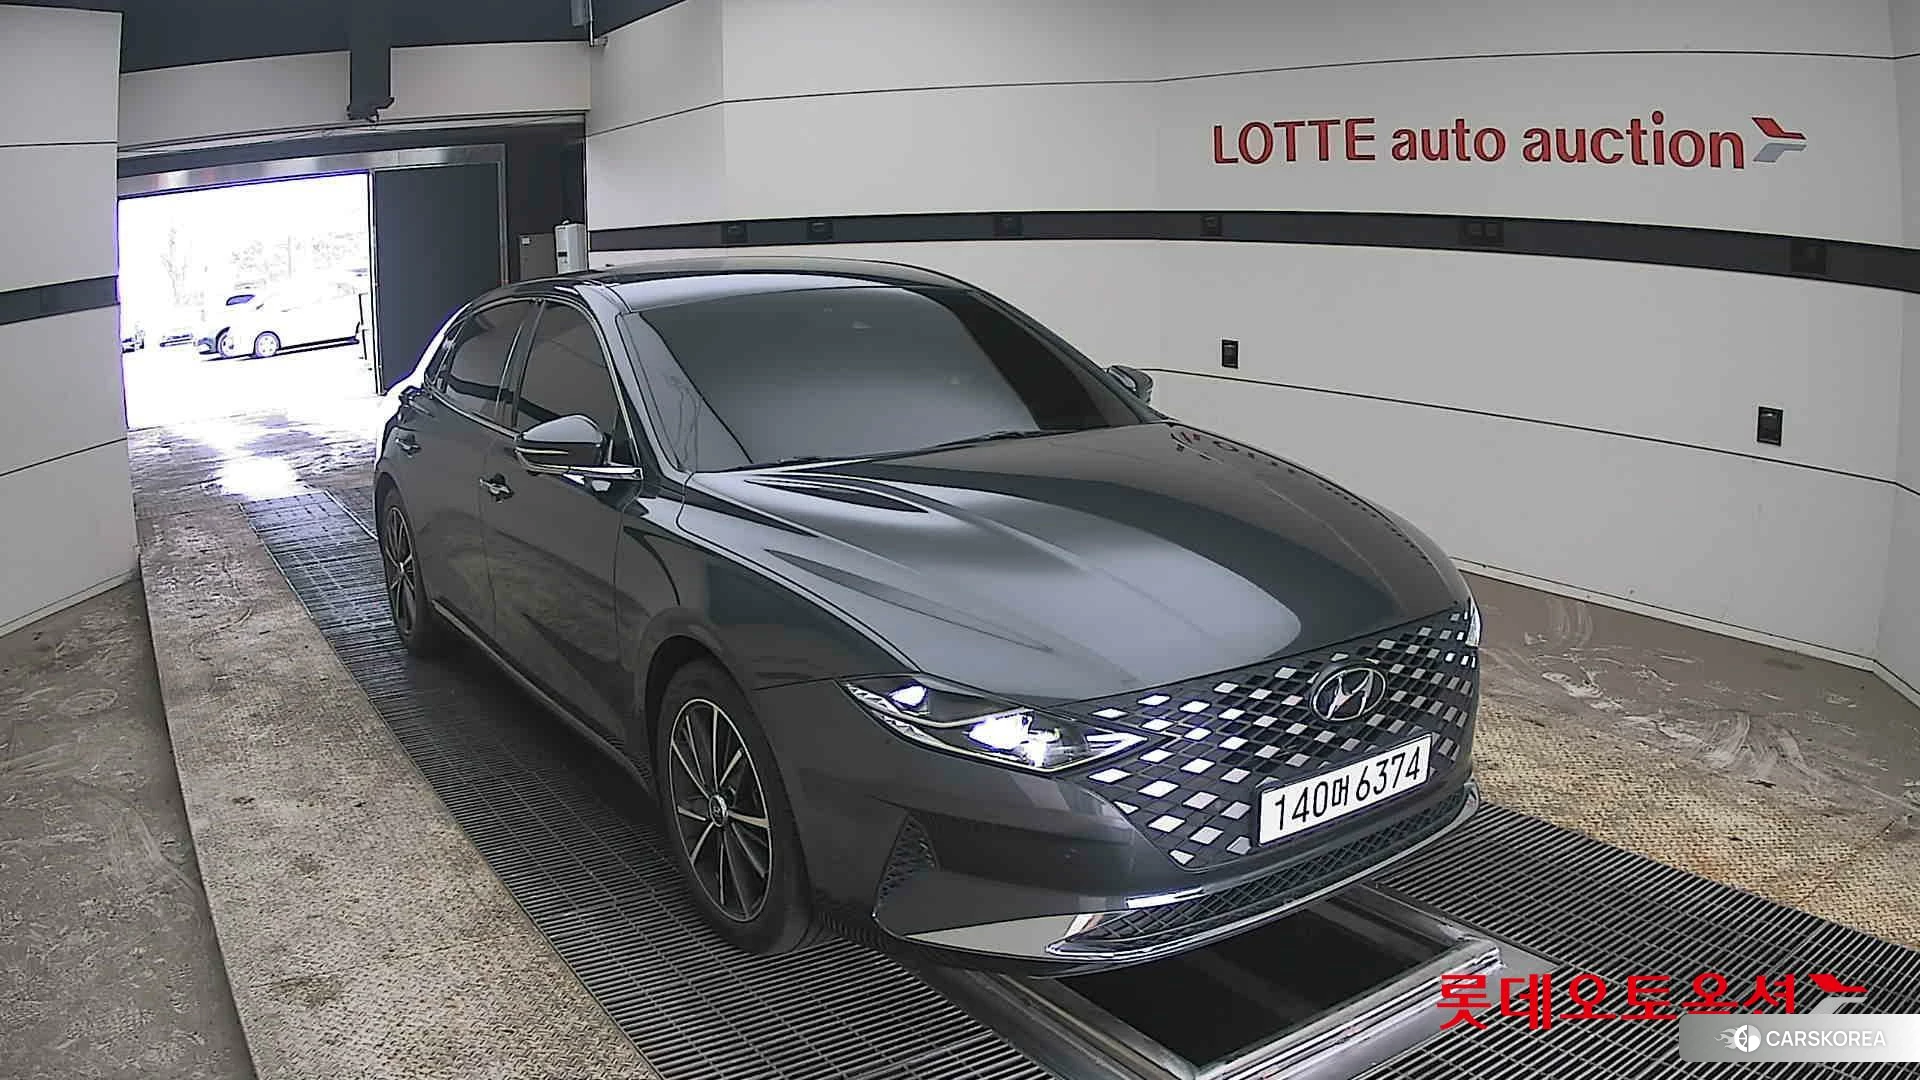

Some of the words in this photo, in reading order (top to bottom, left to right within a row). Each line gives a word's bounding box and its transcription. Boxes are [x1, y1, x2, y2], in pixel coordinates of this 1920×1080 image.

[1213, 118, 1376, 164] LOTTE
[1391, 118, 1507, 162] auto
[1522, 111, 1745, 169] auction
